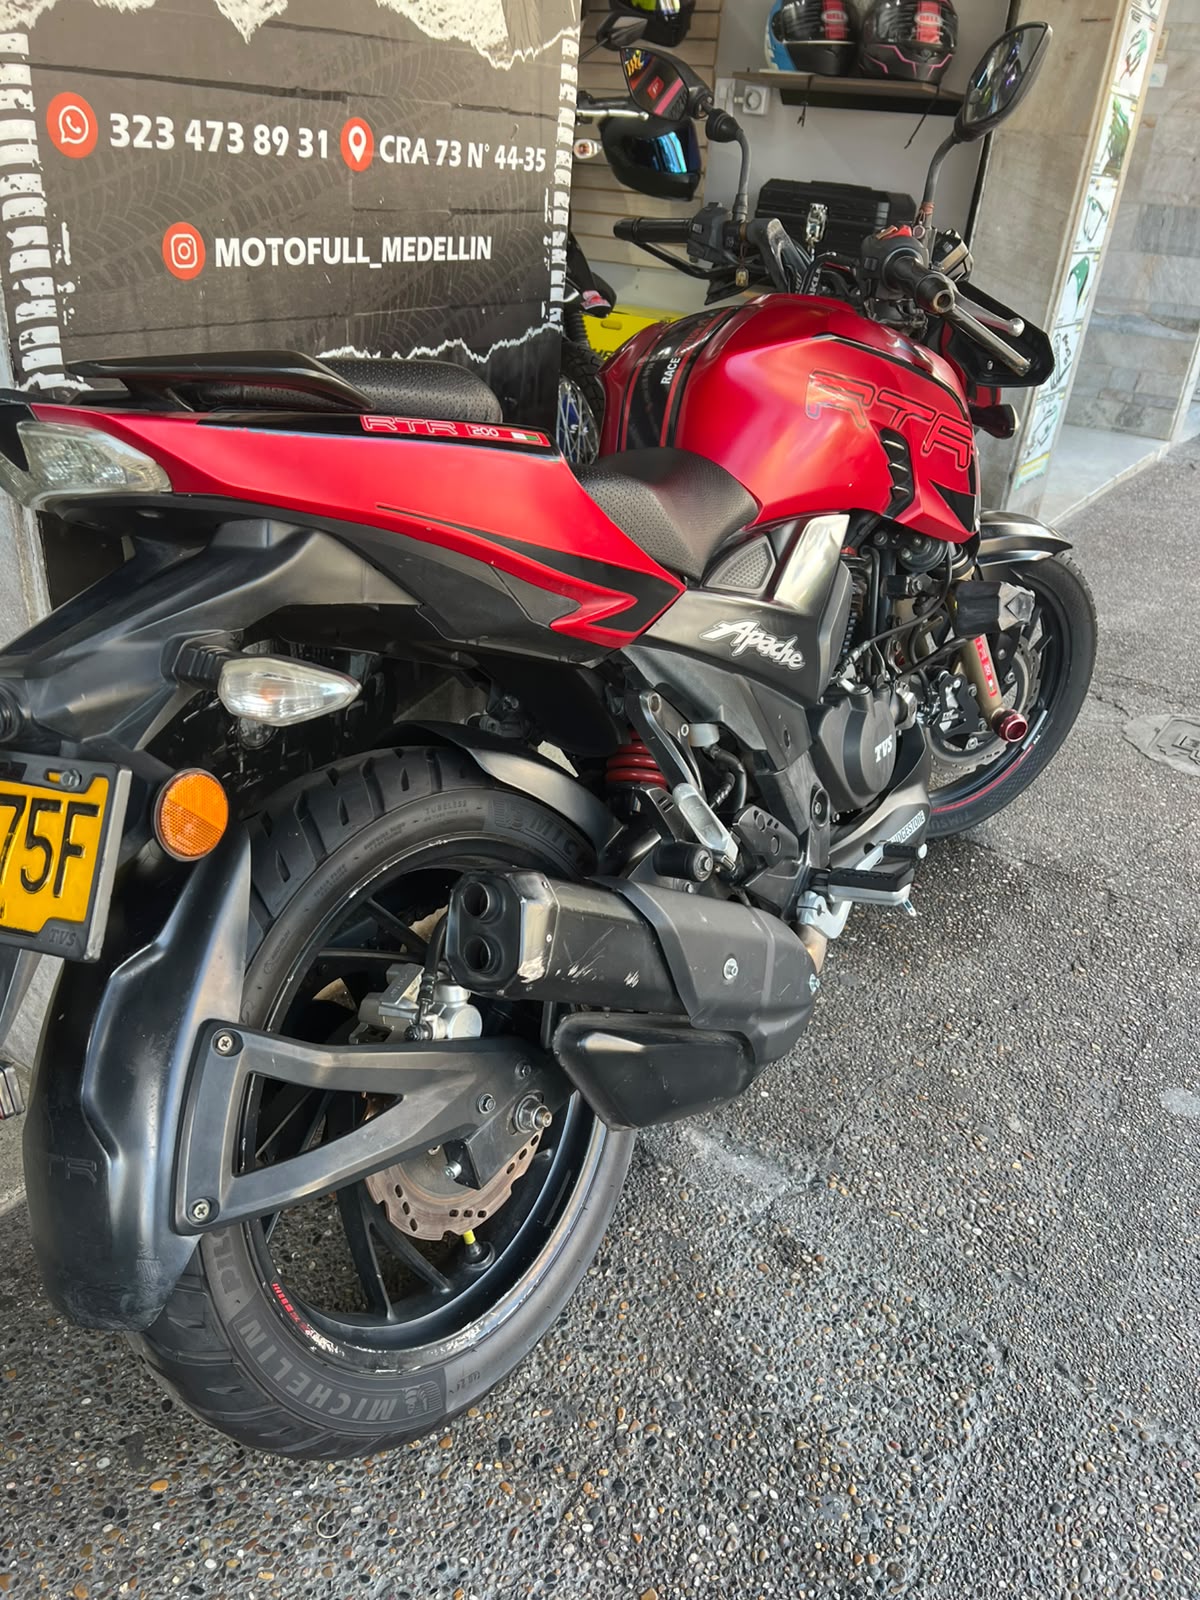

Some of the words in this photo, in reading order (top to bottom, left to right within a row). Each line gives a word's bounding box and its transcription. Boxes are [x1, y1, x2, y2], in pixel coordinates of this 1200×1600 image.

[109, 113, 175, 150] 323
[184, 119, 245, 154] 473
[253, 124, 290, 156] 89
[297, 127, 329, 159] 31
[379, 134, 430, 166] CRA
[435, 139, 463, 168] 73
[494, 145, 547, 173] 44-35
[215, 236, 493, 269] MOTOFULL_MEDELLIN
[660, 356, 681, 385] RACE
[363, 415, 459, 436] RTR
[471, 425, 500, 438] 200
[698, 619, 807, 671] Apache
[874, 734, 893, 763] TVS
[49, 928, 77, 947] TVS
[238, 1317, 399, 1422] MICHELIN
